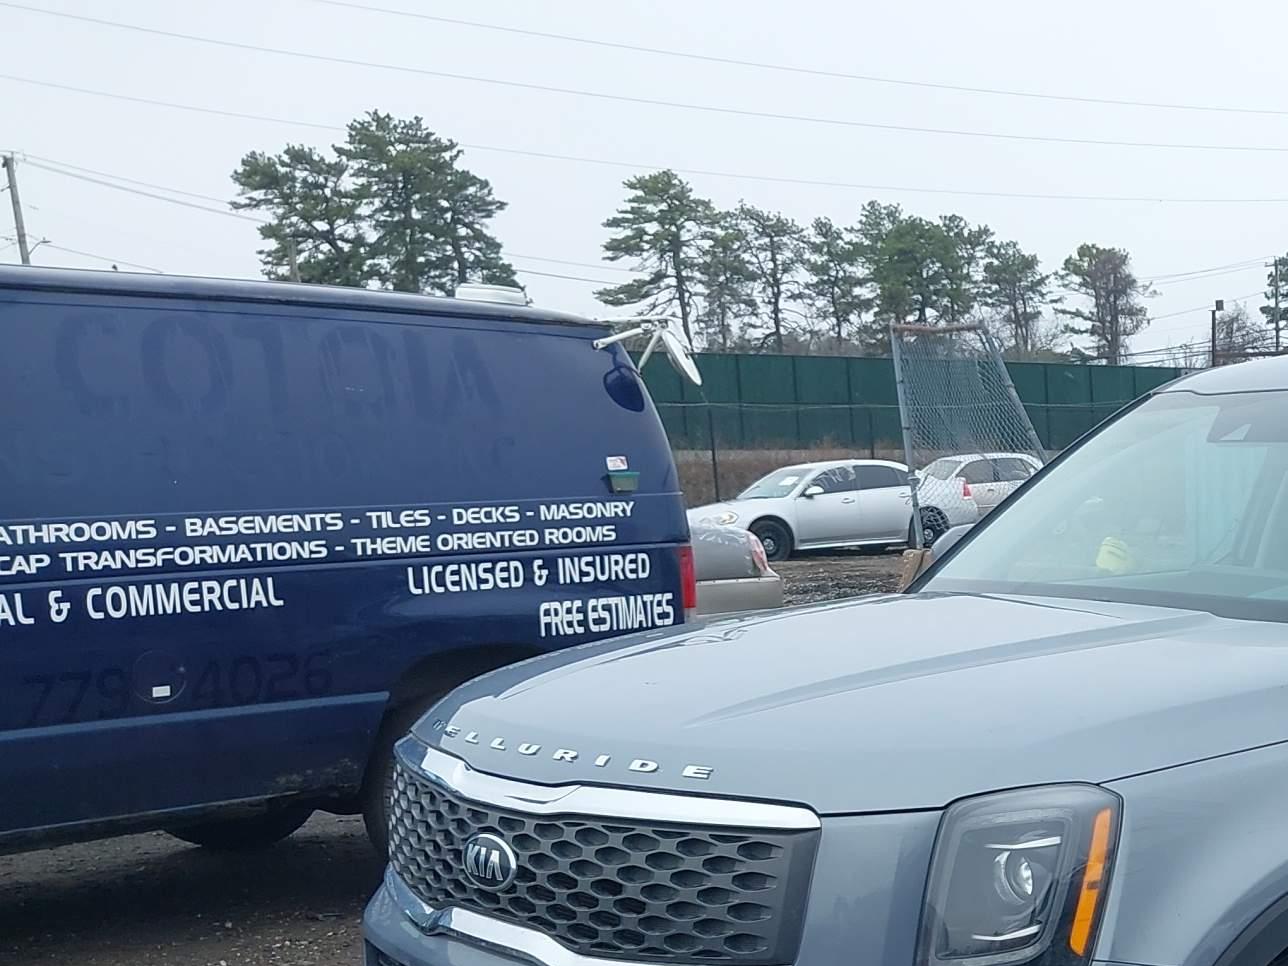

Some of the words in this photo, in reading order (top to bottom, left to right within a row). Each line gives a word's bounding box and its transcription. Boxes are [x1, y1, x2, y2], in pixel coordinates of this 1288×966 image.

[184, 513, 344, 537] BASEMENTS
[366, 509, 431, 529] TILES
[452, 506, 521, 525] DECKS
[539, 501, 634, 521] MASONRY
[59, 540, 328, 572] TRANSFORMATIONS
[351, 535, 431, 556] THEME
[436, 529, 539, 551] ORIENTED
[544, 525, 617, 545] ROOMS
[407, 560, 524, 595] LICENSED
[533, 559, 549, 586] &
[557, 552, 650, 585] INSURED
[48, 590, 71, 623] &
[86, 577, 284, 620] COMMERCIAL
[539, 599, 585, 638] FREE
[587, 592, 675, 633] ESTIMATES
[466, 843, 504, 881] KIA
